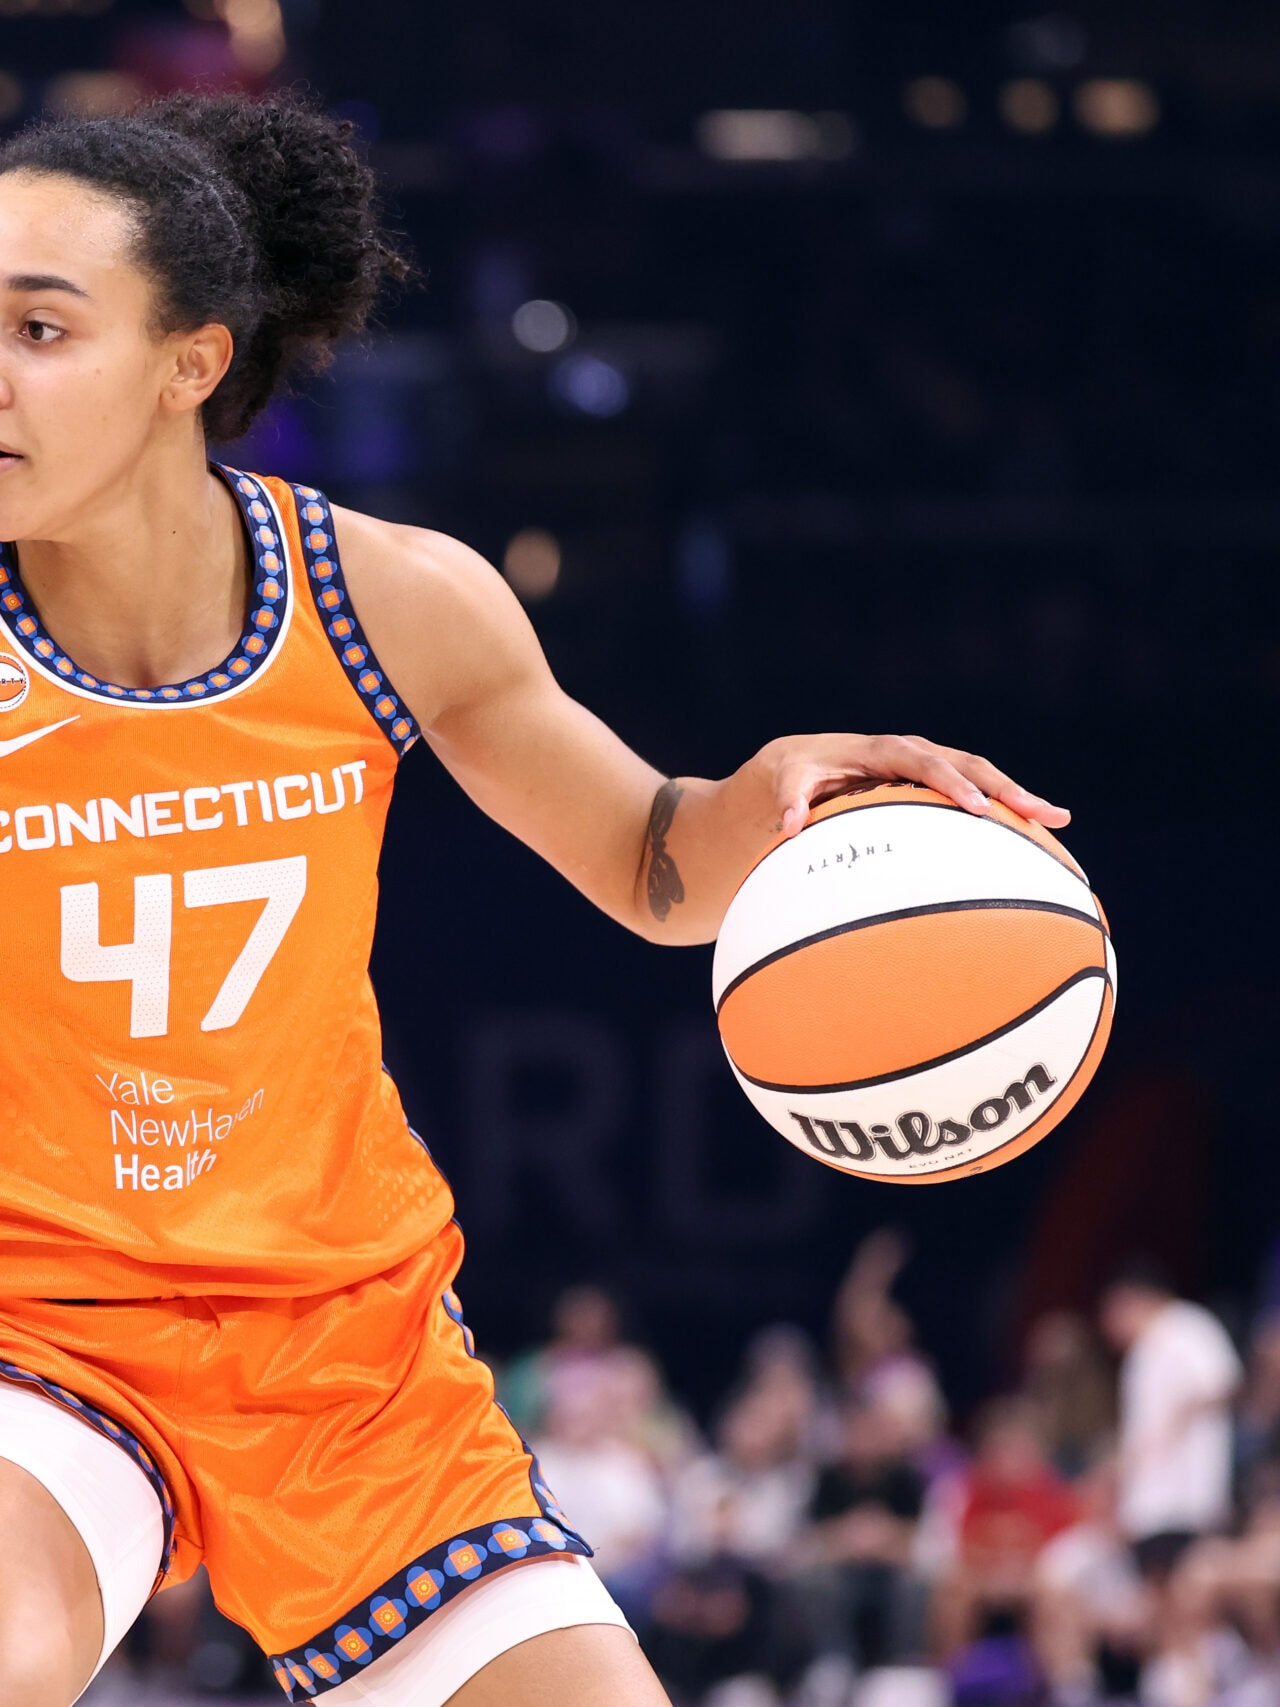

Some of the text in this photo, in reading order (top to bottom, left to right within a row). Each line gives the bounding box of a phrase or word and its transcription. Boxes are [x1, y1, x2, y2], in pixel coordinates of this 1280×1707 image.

[60, 855, 308, 1039] 47
[95, 1071, 175, 1105] Yale
[788, 1062, 1058, 1161] Wilson
[114, 1148, 217, 1191] Health
